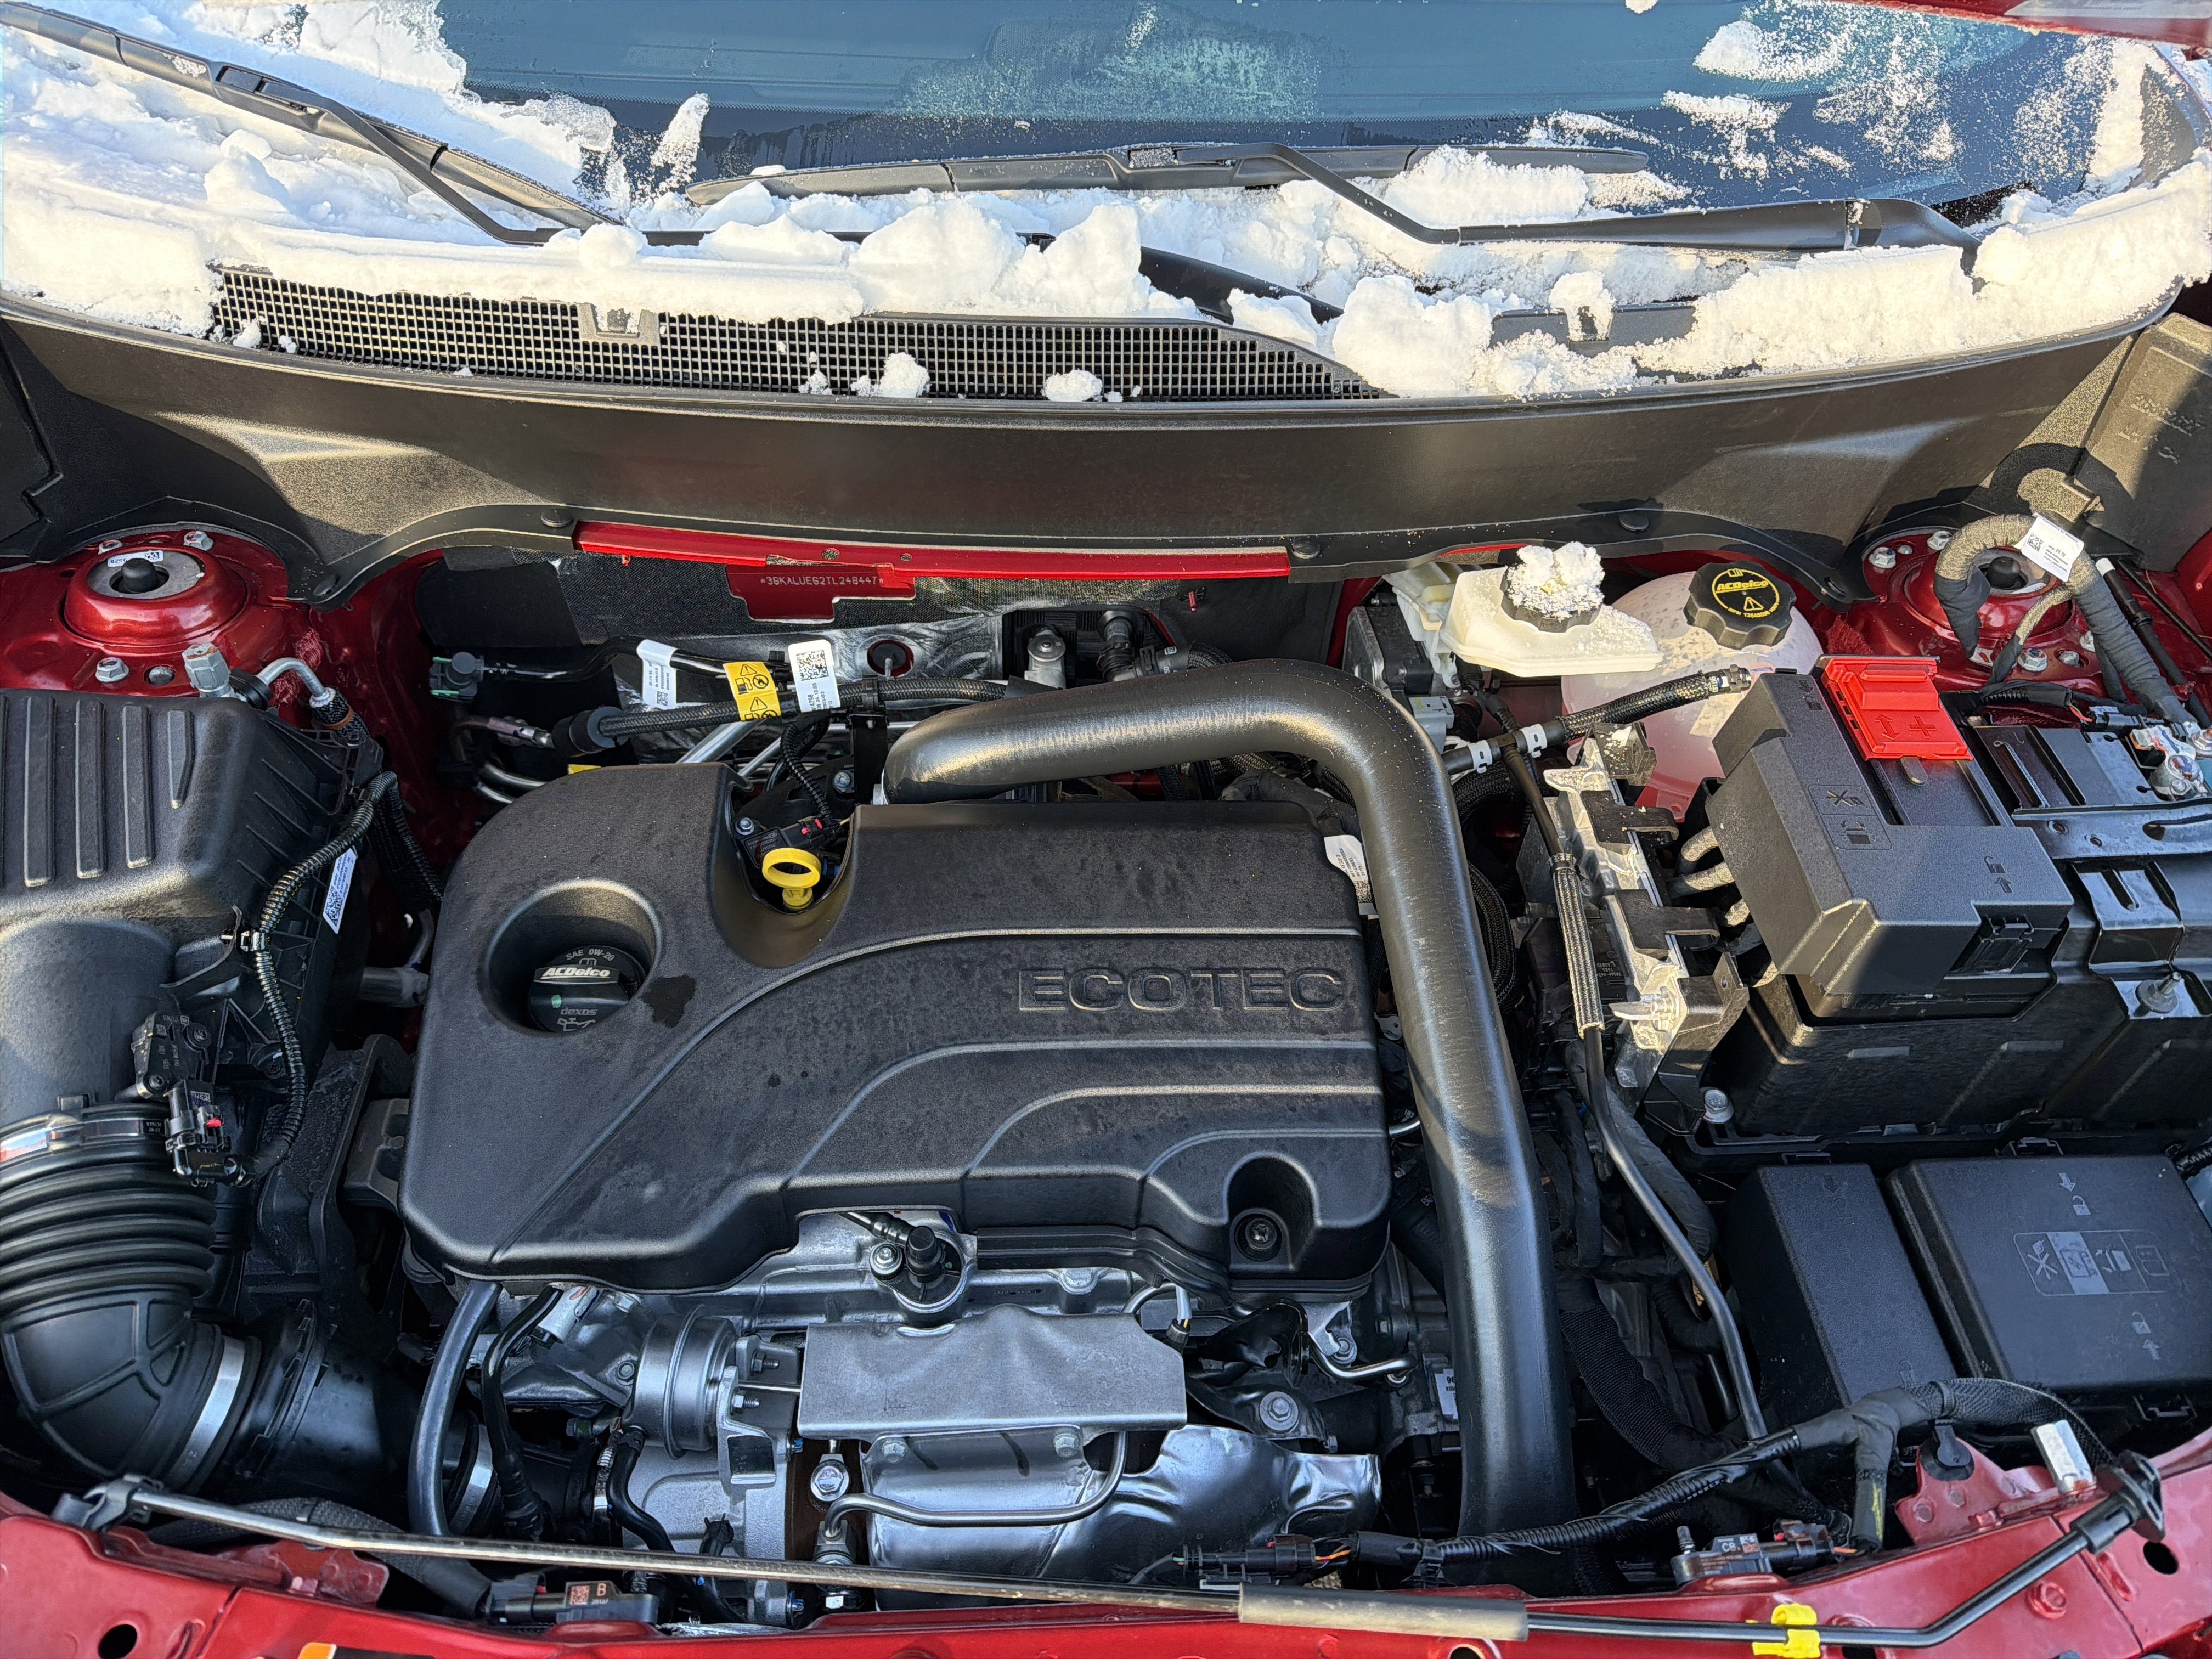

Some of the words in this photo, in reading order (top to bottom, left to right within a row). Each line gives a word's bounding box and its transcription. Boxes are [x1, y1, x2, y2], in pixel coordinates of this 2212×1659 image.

[1716, 580, 1769, 591] ACDelco
[566, 949, 584, 961] SAE
[588, 948, 615, 961] 0W-20
[543, 967, 611, 977] ACDelco
[1018, 967, 1346, 1011] ECOTEC
[560, 1007, 599, 1015] dexos
[596, 1583, 607, 1596] B
